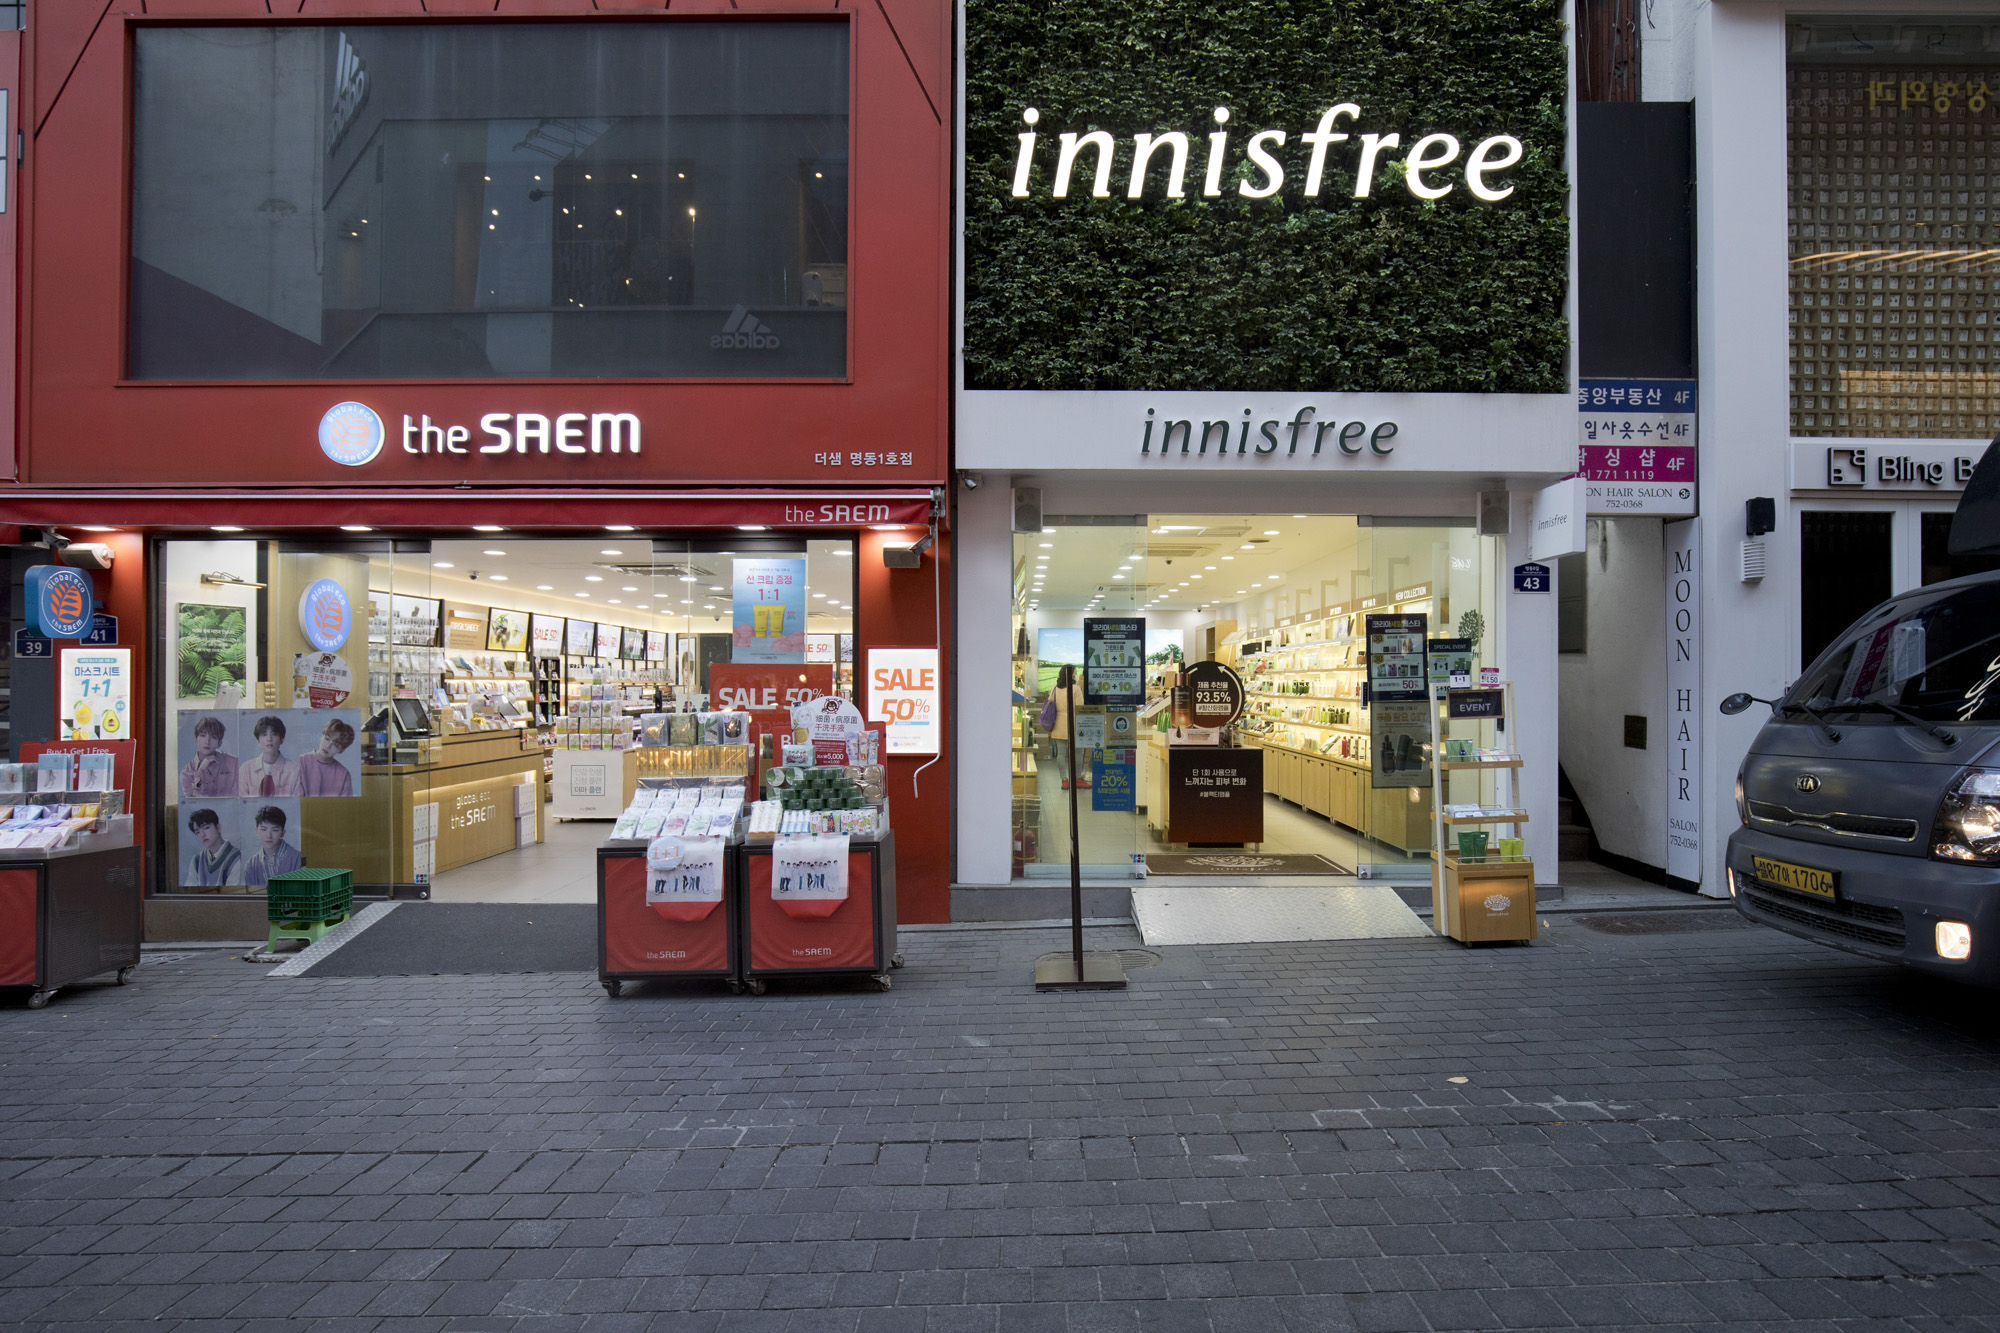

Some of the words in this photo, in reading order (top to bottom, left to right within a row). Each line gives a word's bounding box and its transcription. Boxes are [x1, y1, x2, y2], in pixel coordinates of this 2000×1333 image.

[1011, 102, 1523, 201] innisfree
[1674, 391, 1690, 404] 4F
[326, 405, 357, 423] global
[358, 407, 374, 423] eco
[403, 413, 471, 454] the
[479, 412, 641, 455] SAEM
[1140, 405, 1399, 456] innisfree
[1673, 424, 1690, 437] 4F
[815, 452, 842, 465] 더샘
[850, 452, 913, 465] 명동1호점
[1666, 457, 1685, 471] 4F
[1596, 470, 1618, 479] 771
[1624, 470, 1654, 480] 1119
[1878, 455, 1945, 485] Bling
[1586, 487, 1602, 497] ON
[1606, 488, 1634, 497] HAIR
[1638, 488, 1673, 498] SALON
[1605, 500, 1643, 508] 752-0368
[785, 505, 815, 522] the
[819, 504, 890, 522] SAEM
[1538, 514, 1568, 531] innisfree
[47, 574, 72, 590] global
[73, 578, 85, 593] eco
[746, 575, 755, 584] 선
[757, 575, 774, 584] 크림
[776, 575, 793, 584] 증정
[1523, 577, 1540, 589] 43
[310, 584, 334, 602] global
[335, 590, 346, 606] eco
[1395, 590, 1404, 600] NEW
[1404, 586, 1427, 600] COLLECTION
[1673, 549, 1692, 662] MOON
[51, 618, 62, 630] the
[62, 619, 83, 632] SAEM
[90, 629, 106, 641] 41
[25, 642, 42, 654] 39
[874, 668, 934, 691] SALE
[1197, 681, 1210, 689] 제품
[81, 679, 111, 697] 1+1
[719, 687, 777, 709] SALE
[1196, 691, 1231, 702] 93.5%
[881, 698, 931, 726] 50%
[1459, 703, 1491, 712] EVENT
[1676, 689, 1692, 801] HAIR
[1100, 775, 1128, 787] 20%
[1185, 777, 1214, 786] 느껴지는
[1215, 777, 1230, 786] 피부
[1232, 777, 1247, 786] 변화
[1796, 777, 1814, 790] KIA
[466, 805, 496, 825] SAEM
[1669, 817, 1698, 833] SALON
[1669, 834, 1698, 851] 752-0368
[651, 845, 681, 860] 1+1
[1793, 868, 1830, 893] 1706
[646, 951, 658, 959] the
[659, 951, 686, 959] SAEM
[792, 948, 804, 956] the
[804, 948, 832, 956] SAEM
